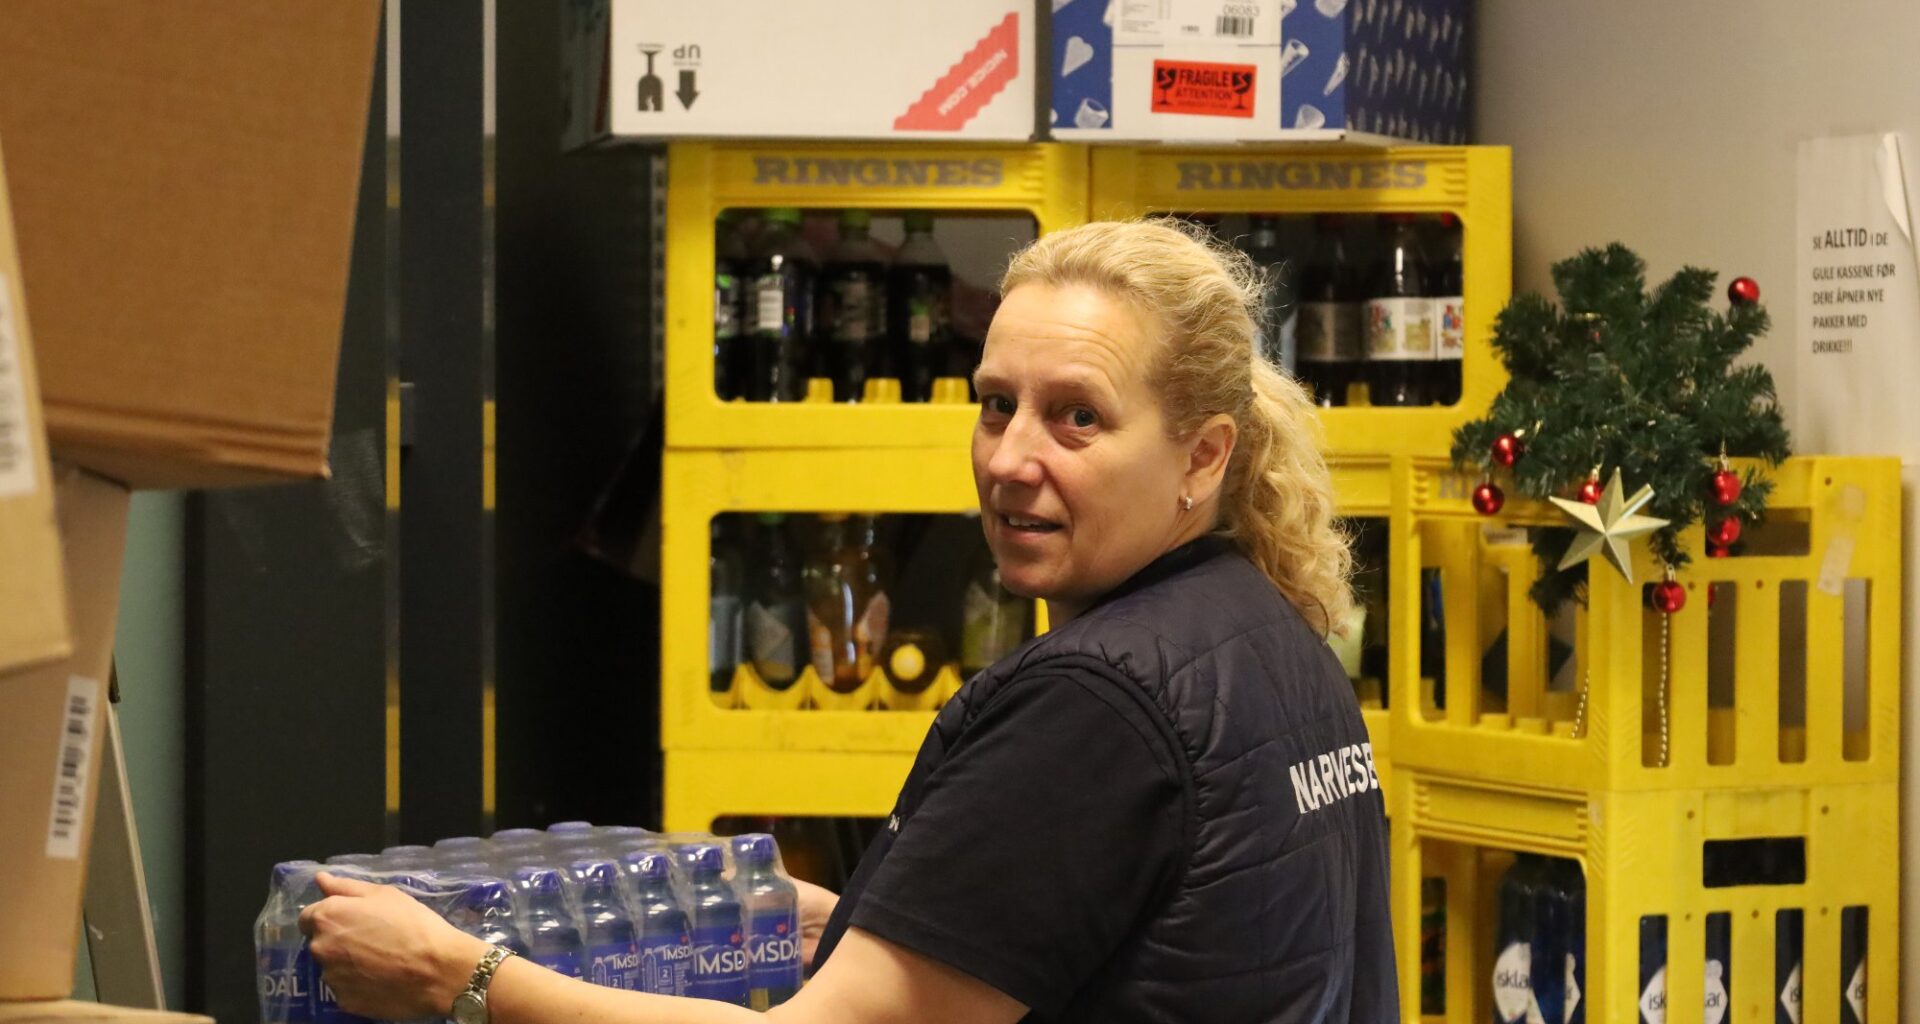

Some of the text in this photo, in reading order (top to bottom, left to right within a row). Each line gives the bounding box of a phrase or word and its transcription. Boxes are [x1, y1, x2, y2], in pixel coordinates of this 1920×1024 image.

[673, 44, 701, 59] UP
[1178, 70, 1230, 87] FRAGILE
[1175, 87, 1232, 100] ATTENTION
[753, 157, 1003, 187] RINGNES
[1177, 161, 1427, 190] RINGNES
[1812, 236, 1821, 250] SE
[1825, 229, 1867, 248] ALLTID
[1876, 232, 1888, 247] DE
[1812, 263, 1896, 281] GULE KASSENE FØR
[1813, 287, 1884, 304] DERE ÅPNER NYE
[1813, 314, 1867, 328] PAKKER MED
[1289, 742, 1378, 814] NARVESE
[693, 949, 749, 975] IMSD
